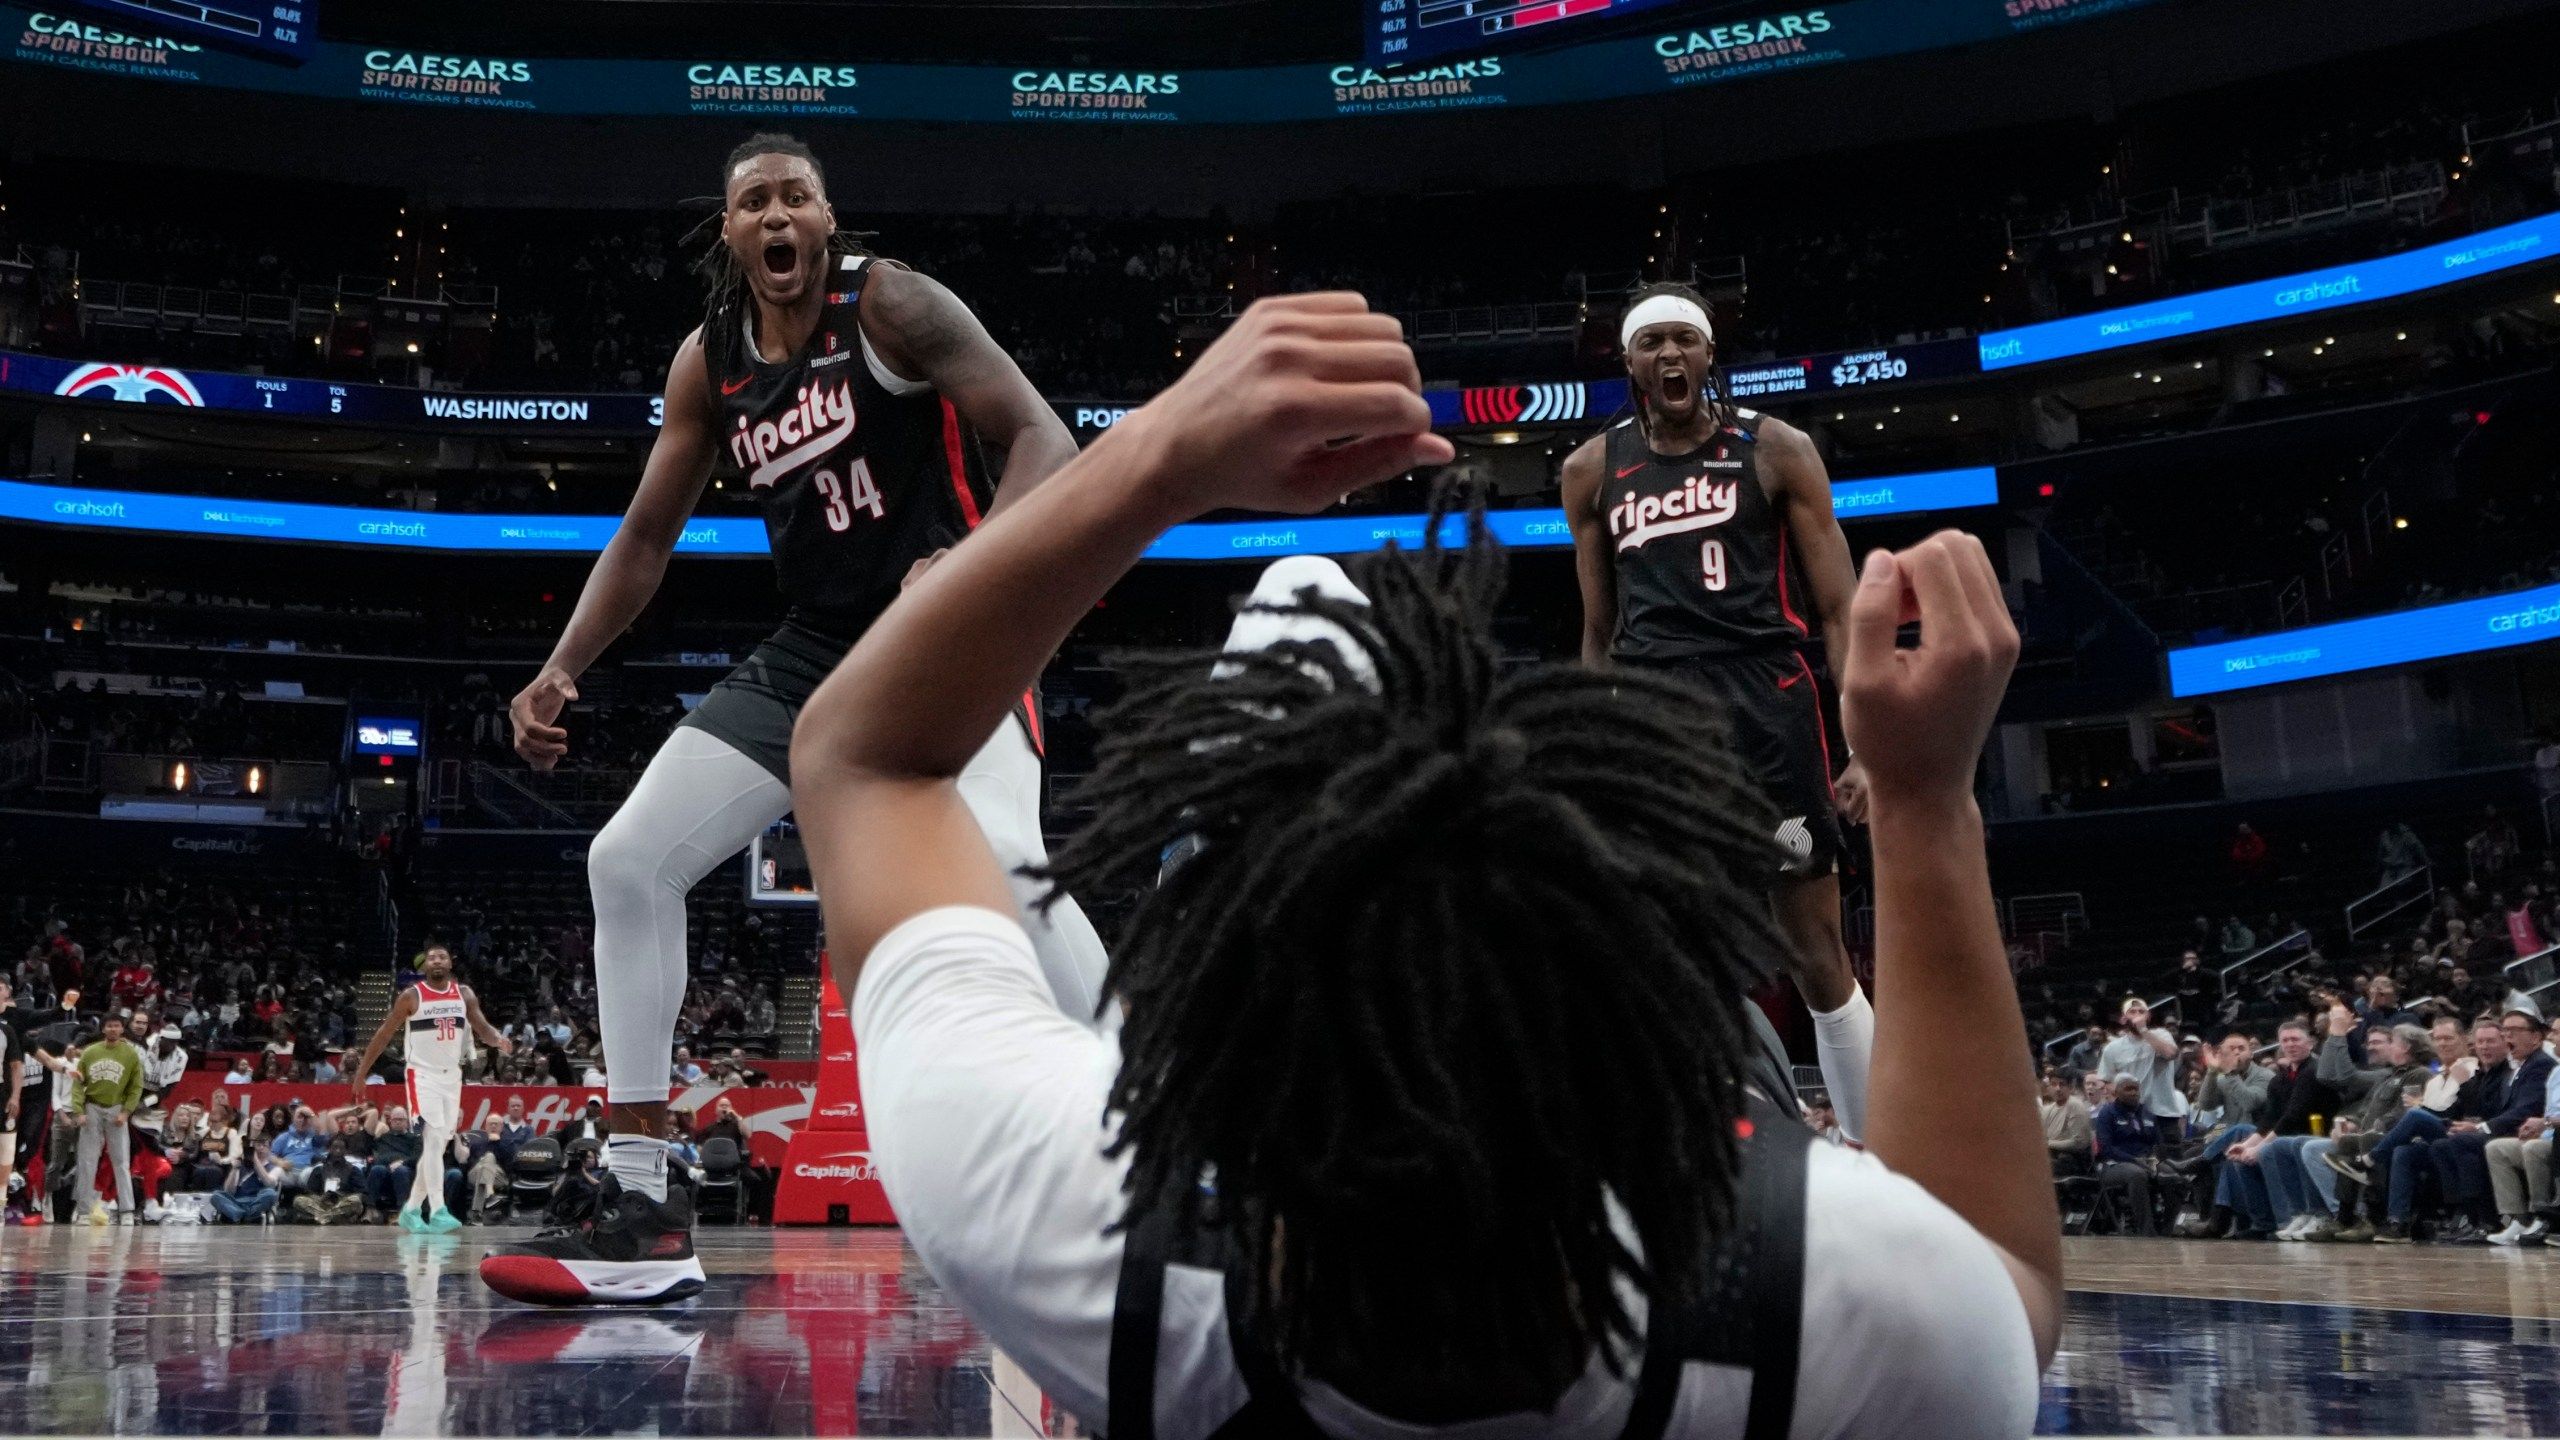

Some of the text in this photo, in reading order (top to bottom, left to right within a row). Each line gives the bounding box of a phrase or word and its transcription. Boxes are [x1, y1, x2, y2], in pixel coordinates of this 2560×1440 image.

[1494, 17, 1504, 31] 2
[1655, 11, 1831, 57] CAESARS
[20, 30, 168, 65] SPORTSBOOK
[1663, 37, 1807, 73] SPORTSBOOK
[364, 50, 531, 82] CAESARS
[362, 70, 501, 95] SPORTSBOOK
[687, 64, 857, 87] CAESARS
[1012, 72, 1179, 94] CAESARS
[690, 86, 826, 101] SPORTSBOOK
[1335, 80, 1473, 102] SPORTSBOOK
[690, 103, 724, 112] WITH
[728, 104, 788, 113] CAESARS
[1012, 92, 1148, 109] SPORTSBOOK
[1011, 110, 1045, 119] WITH
[1050, 111, 1108, 120] CAESARS
[2275, 275, 2361, 307] carahsoft
[2100, 320, 2132, 336] DELL
[811, 350, 851, 368] BRIGHTSIDE
[1842, 351, 1888, 366] JACKPOT
[1730, 365, 1805, 384] FOUNDATION
[1831, 358, 1908, 387] $2,450
[256, 381, 287, 392] FOULS
[329, 385, 347, 397] TOL
[1731, 382, 1765, 397] 50/50
[1767, 380, 1807, 393] RAFFLE
[264, 392, 273, 408] 1
[331, 397, 342, 413] 5
[423, 396, 588, 420] WASHINGTON
[731, 375, 857, 490] ripcity
[814, 456, 885, 531] 34
[1832, 488, 1895, 509] arahsoft
[54, 500, 125, 517] carahsoft
[203, 511, 230, 522] DELL
[1609, 474, 1739, 553] ripcity
[359, 521, 427, 537] carahsoft
[501, 527, 527, 538] DELL
[1232, 531, 1298, 549] carahsoft
[1701, 540, 1728, 592] 9
[2488, 603, 2560, 633] carahso
[2224, 656, 2257, 673] DELL
[423, 1004, 463, 1015] wizards
[433, 1017, 457, 1042] 36
